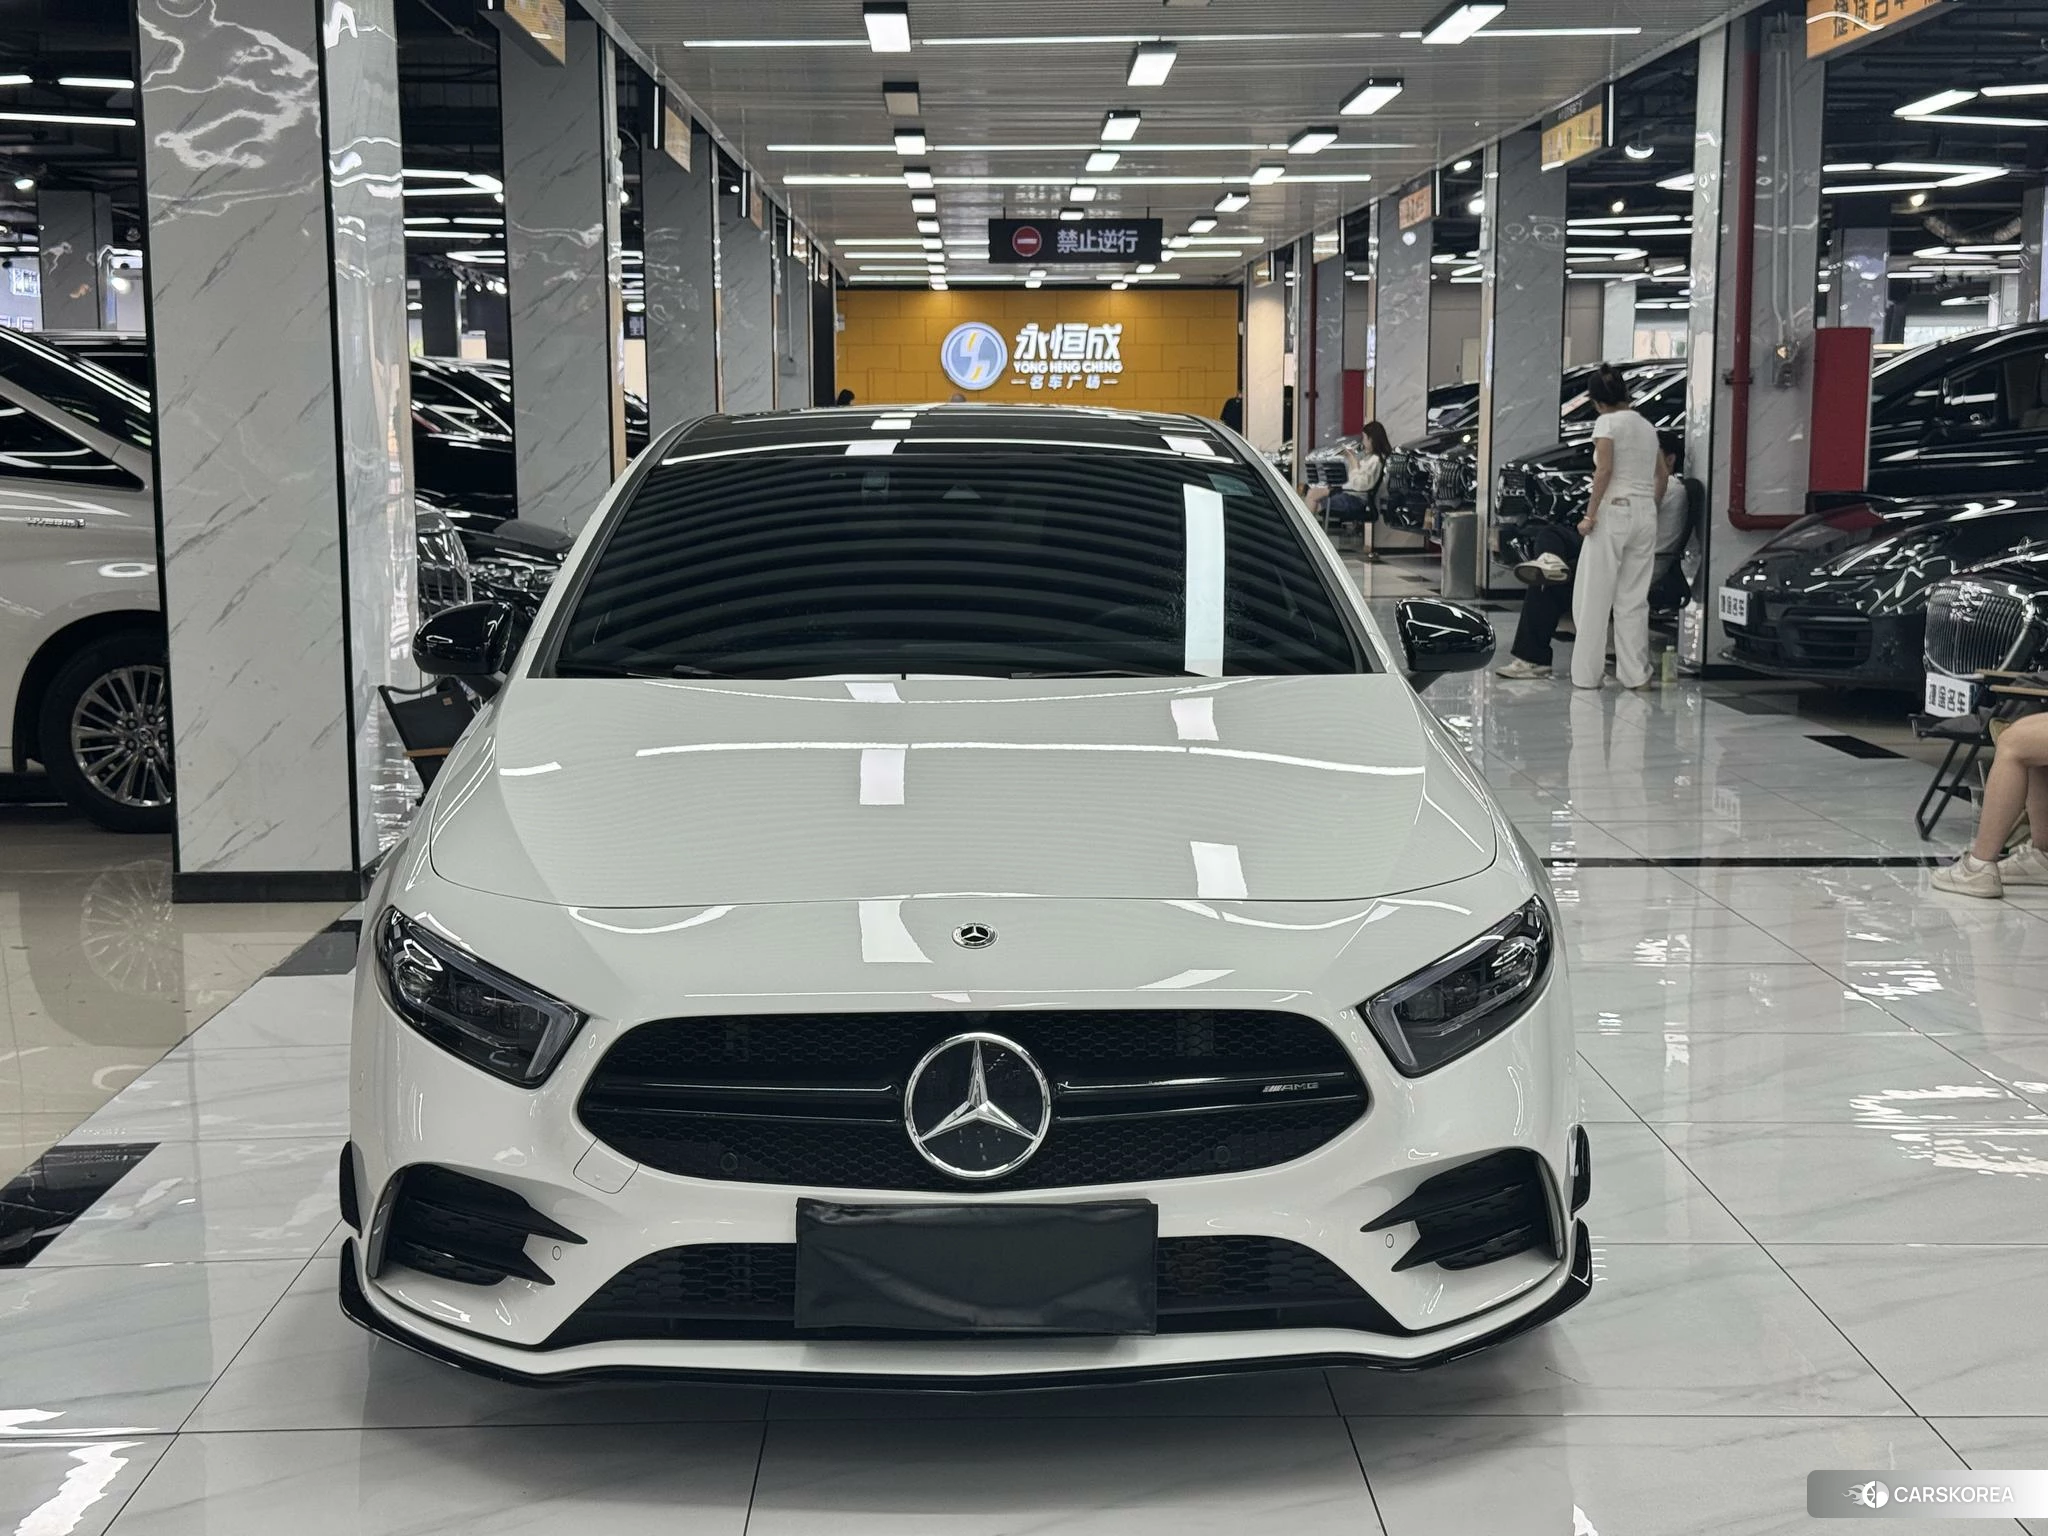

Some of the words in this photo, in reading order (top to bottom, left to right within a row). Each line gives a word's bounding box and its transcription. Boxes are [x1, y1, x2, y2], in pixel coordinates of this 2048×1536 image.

[1057, 229, 1138, 253] 禁止逆行
[1013, 323, 1122, 359] 永恒成
[1013, 360, 1048, 373] YONG
[1049, 360, 1081, 373] HENG
[1082, 360, 1123, 373] CHENG
